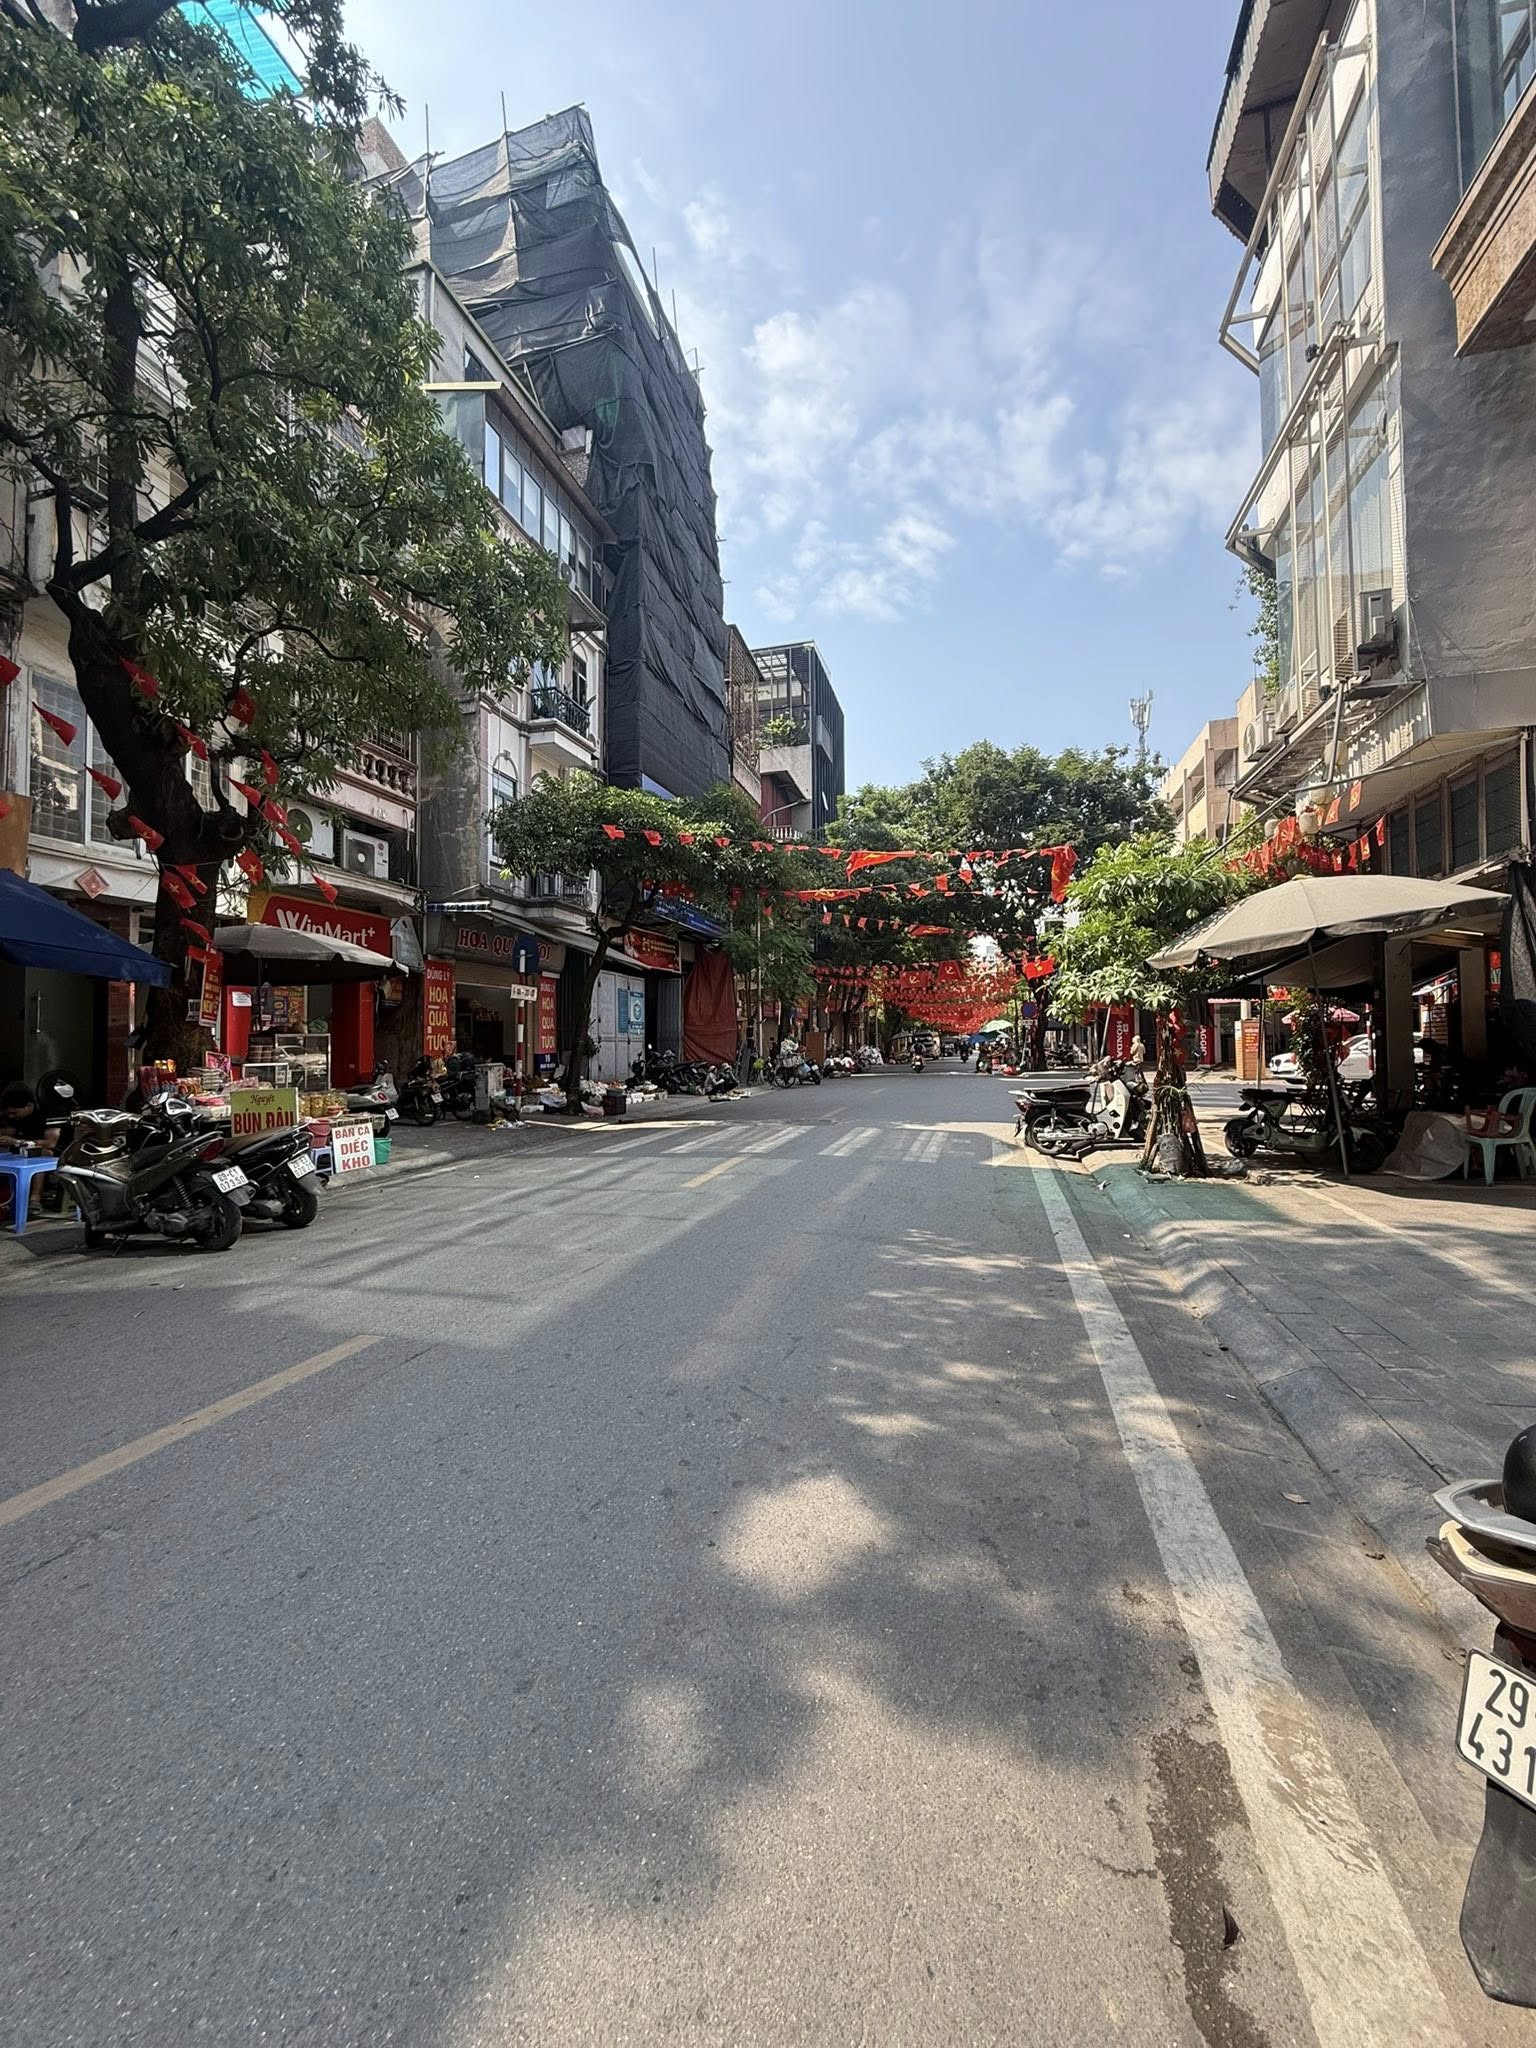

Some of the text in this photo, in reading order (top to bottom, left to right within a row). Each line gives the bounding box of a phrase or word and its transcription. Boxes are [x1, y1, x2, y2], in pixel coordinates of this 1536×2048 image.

[458, 928, 489, 951] HOA
[429, 986, 449, 1003] HOA
[1116, 1020, 1124, 1058] HONDA
[233, 1108, 262, 1134] BÚN
